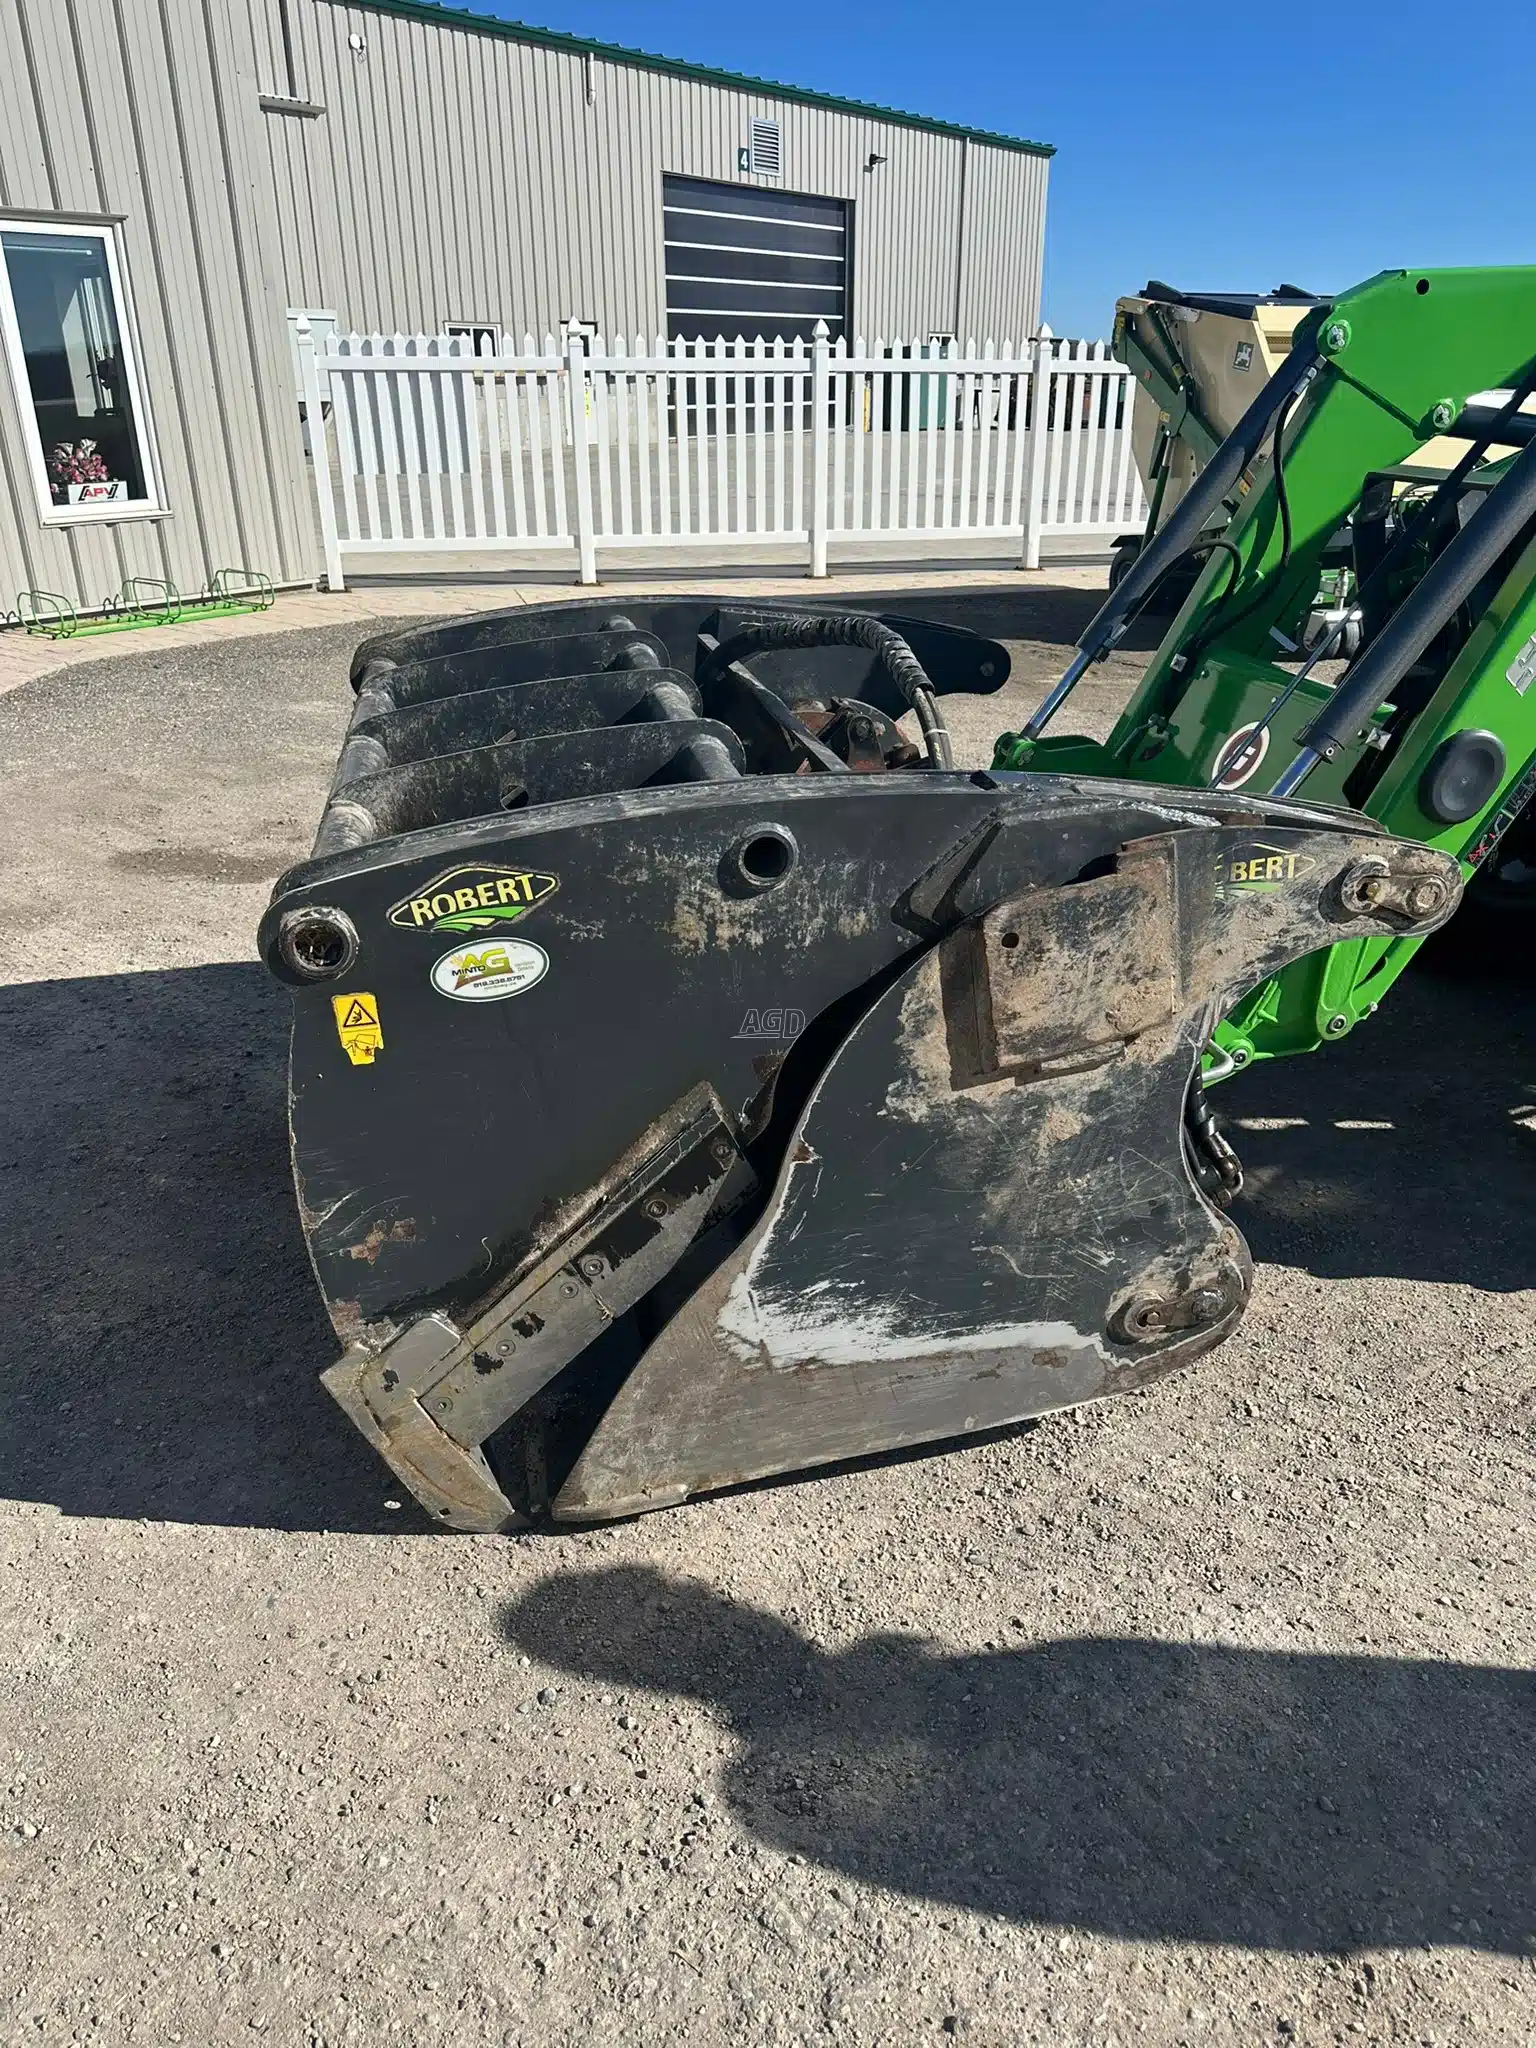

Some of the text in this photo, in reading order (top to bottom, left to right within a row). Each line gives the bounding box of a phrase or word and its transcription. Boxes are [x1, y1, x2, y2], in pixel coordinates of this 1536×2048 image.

[740, 150, 749, 169] 4
[410, 873, 535, 926] ROBERT
[451, 965, 486, 976] MINTO
